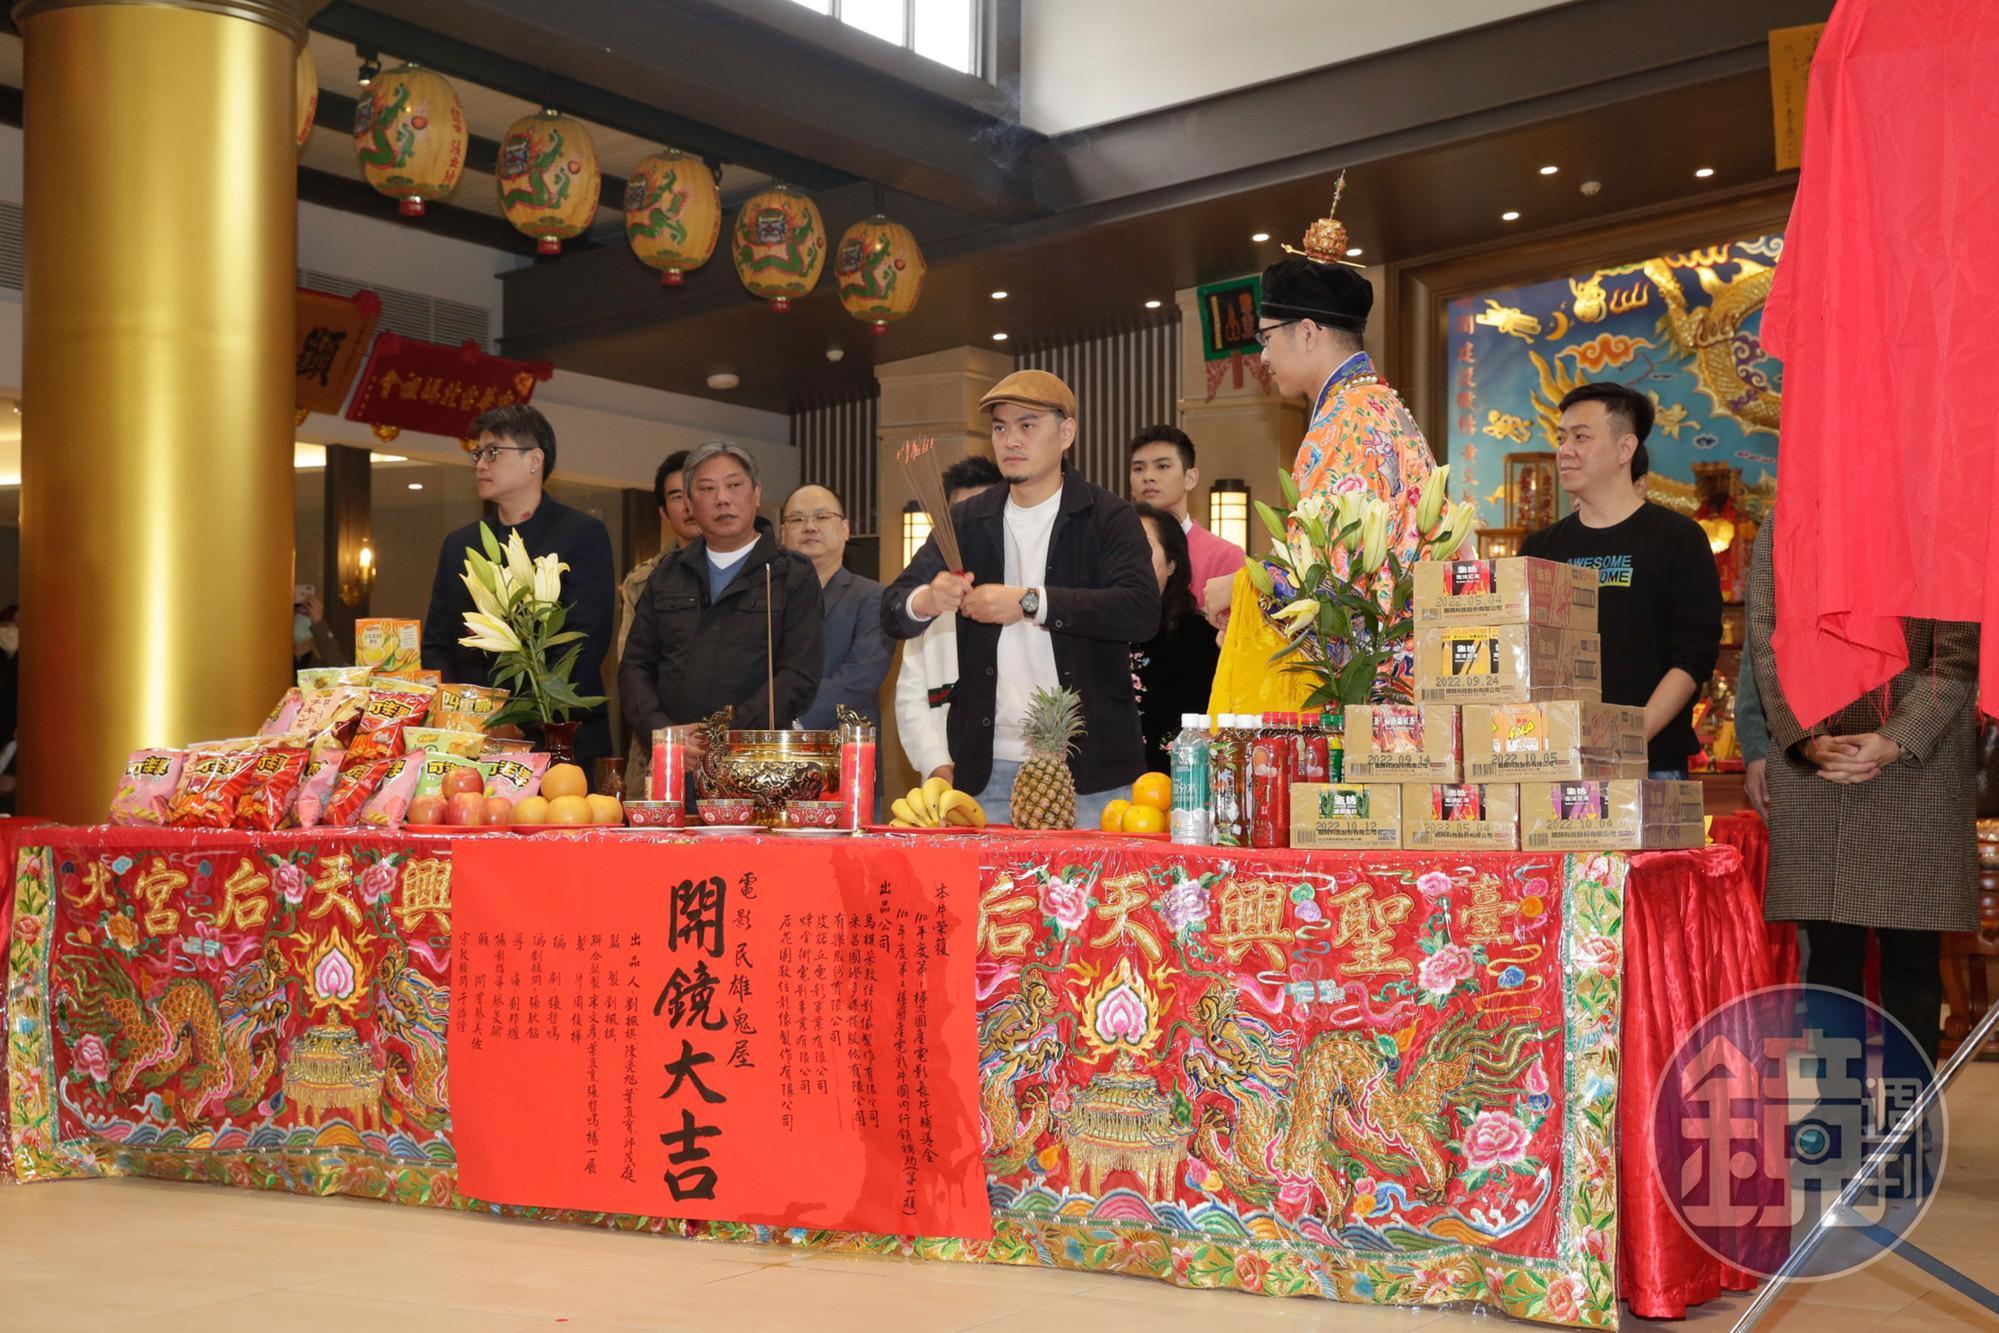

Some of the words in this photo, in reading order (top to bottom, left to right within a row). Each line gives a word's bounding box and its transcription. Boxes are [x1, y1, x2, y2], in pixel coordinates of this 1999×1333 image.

[1435, 676, 1499, 687] 2022.09.24
[126, 756, 170, 775] 可樂果
[879, 880, 893, 954] 出品公司
[727, 872, 757, 1068] 電影民雄鬼屋
[653, 875, 728, 1203] 開鏡大吉
